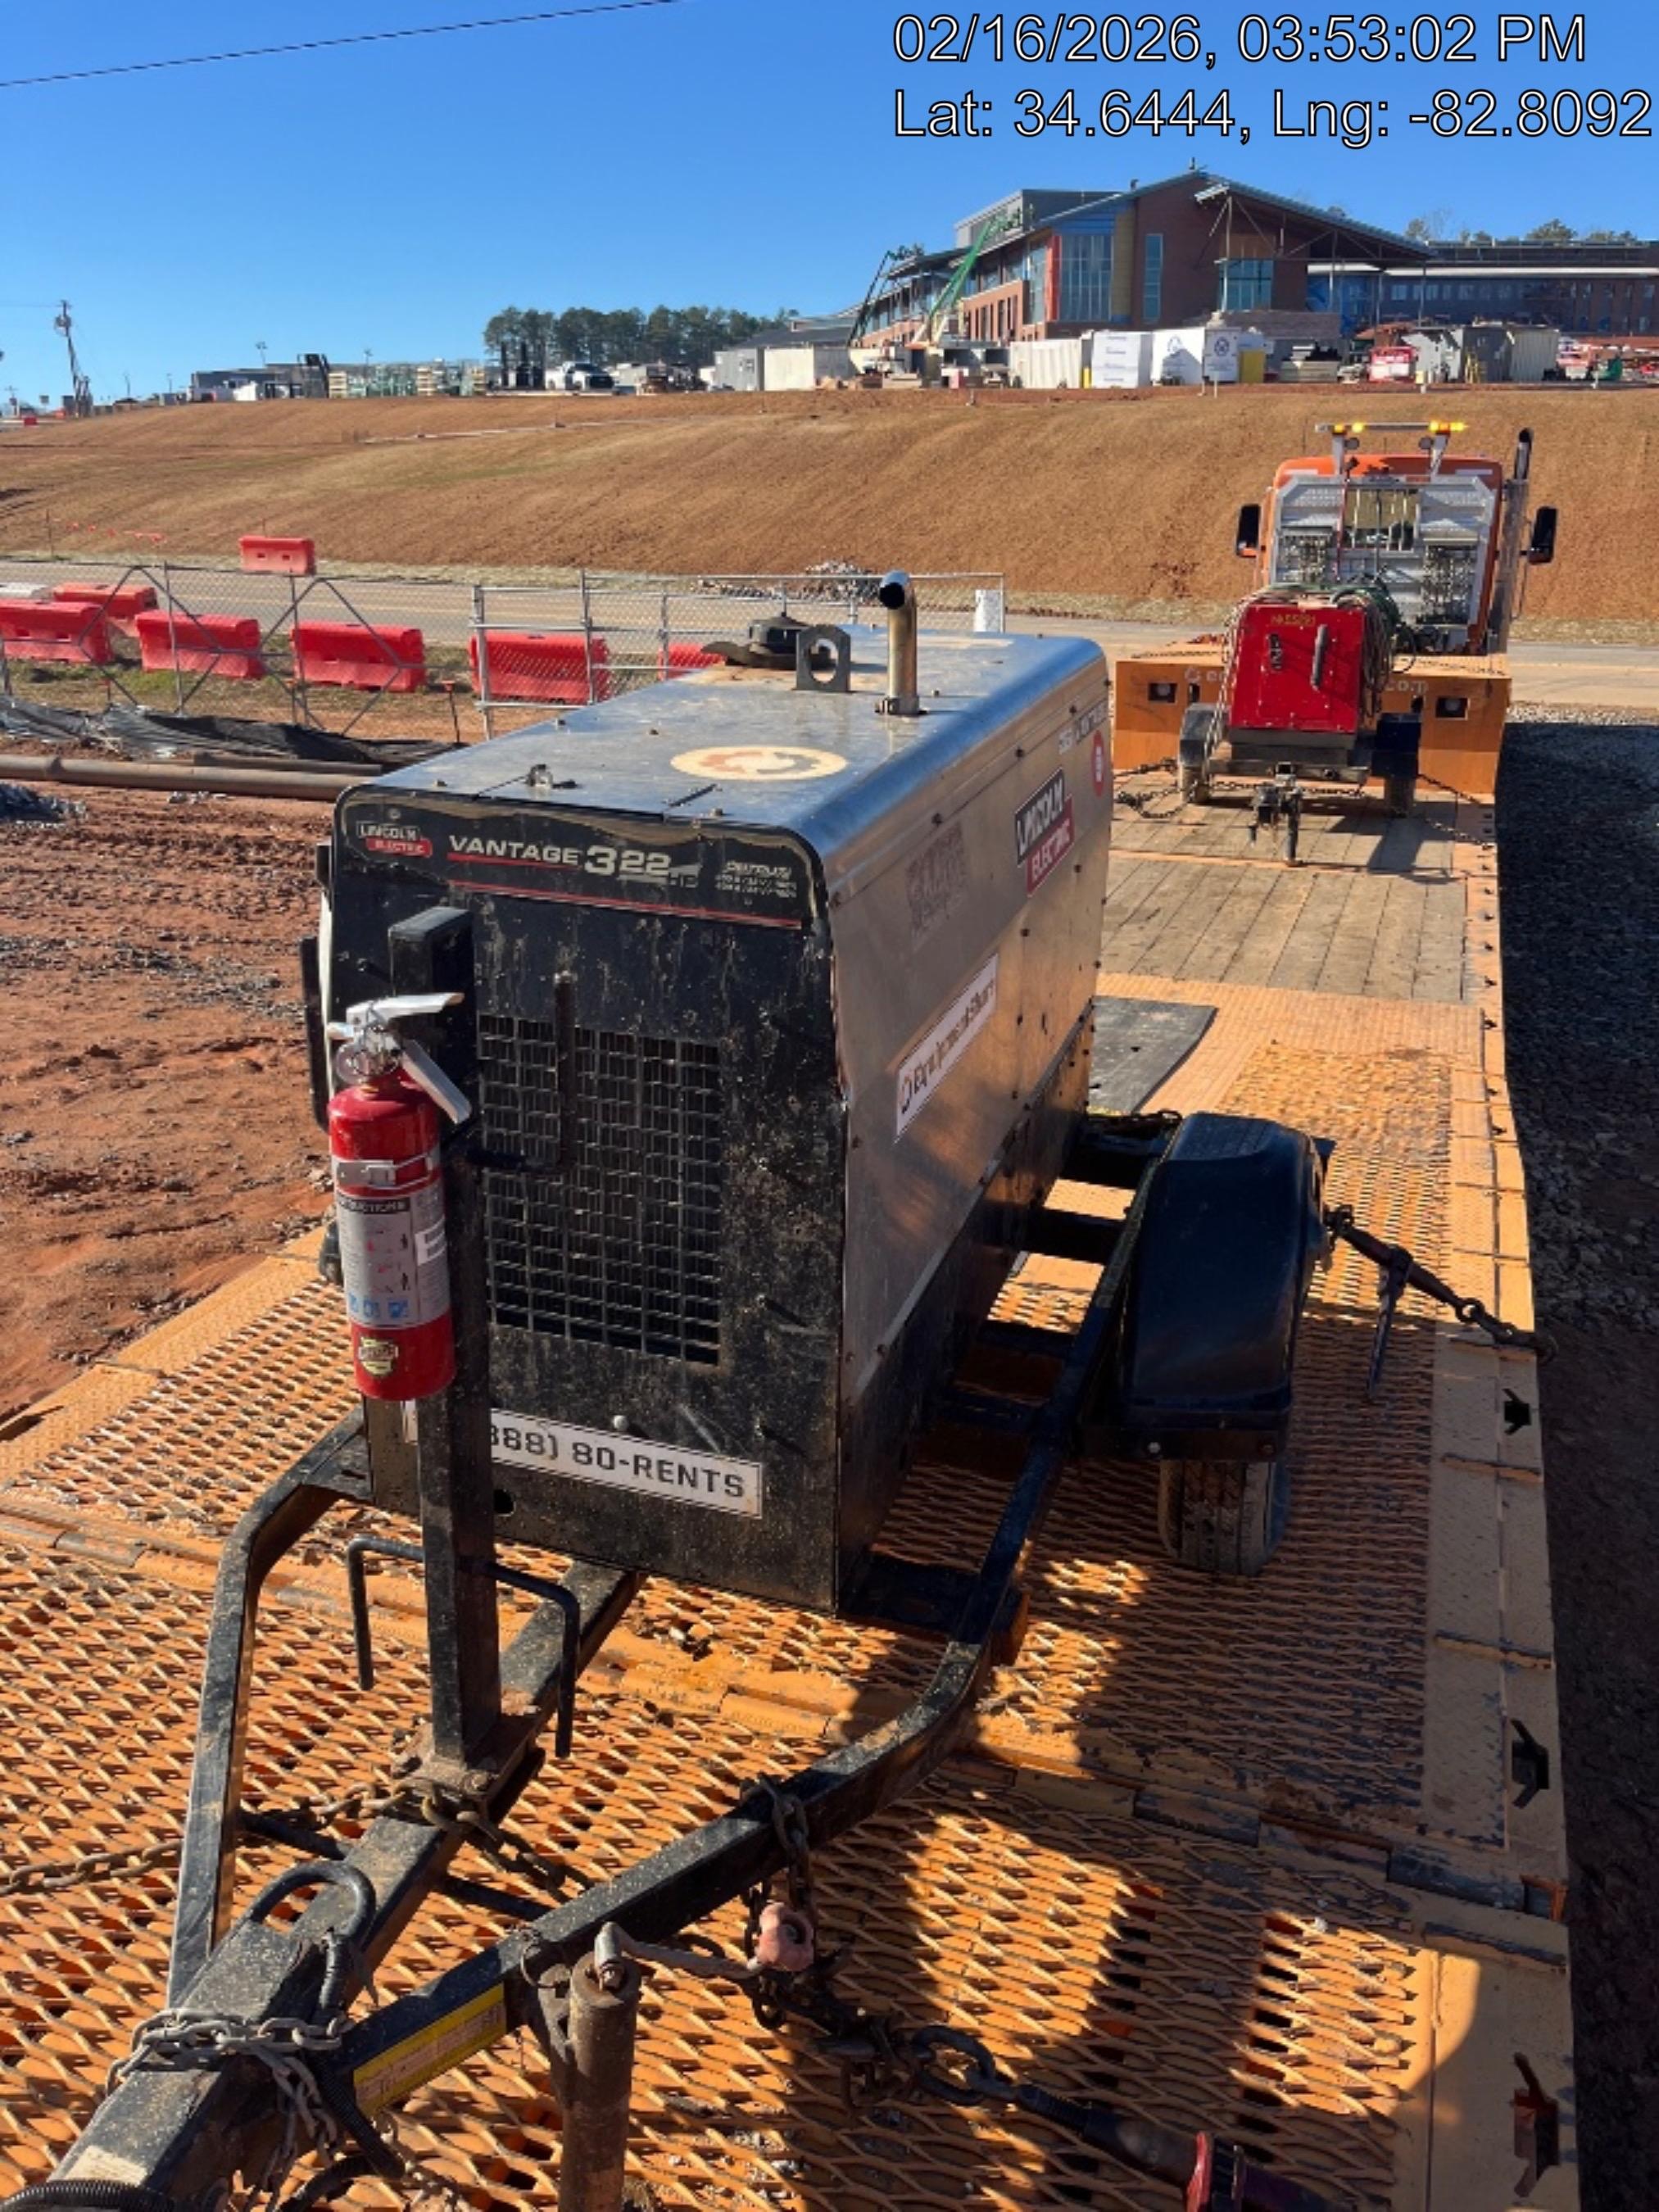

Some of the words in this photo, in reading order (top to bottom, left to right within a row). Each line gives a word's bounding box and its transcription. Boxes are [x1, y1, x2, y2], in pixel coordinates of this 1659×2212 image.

[448, 834, 579, 866] VANTAGE
[582, 845, 672, 877] 322
[573, 1442, 745, 1498] 80-RENTS
